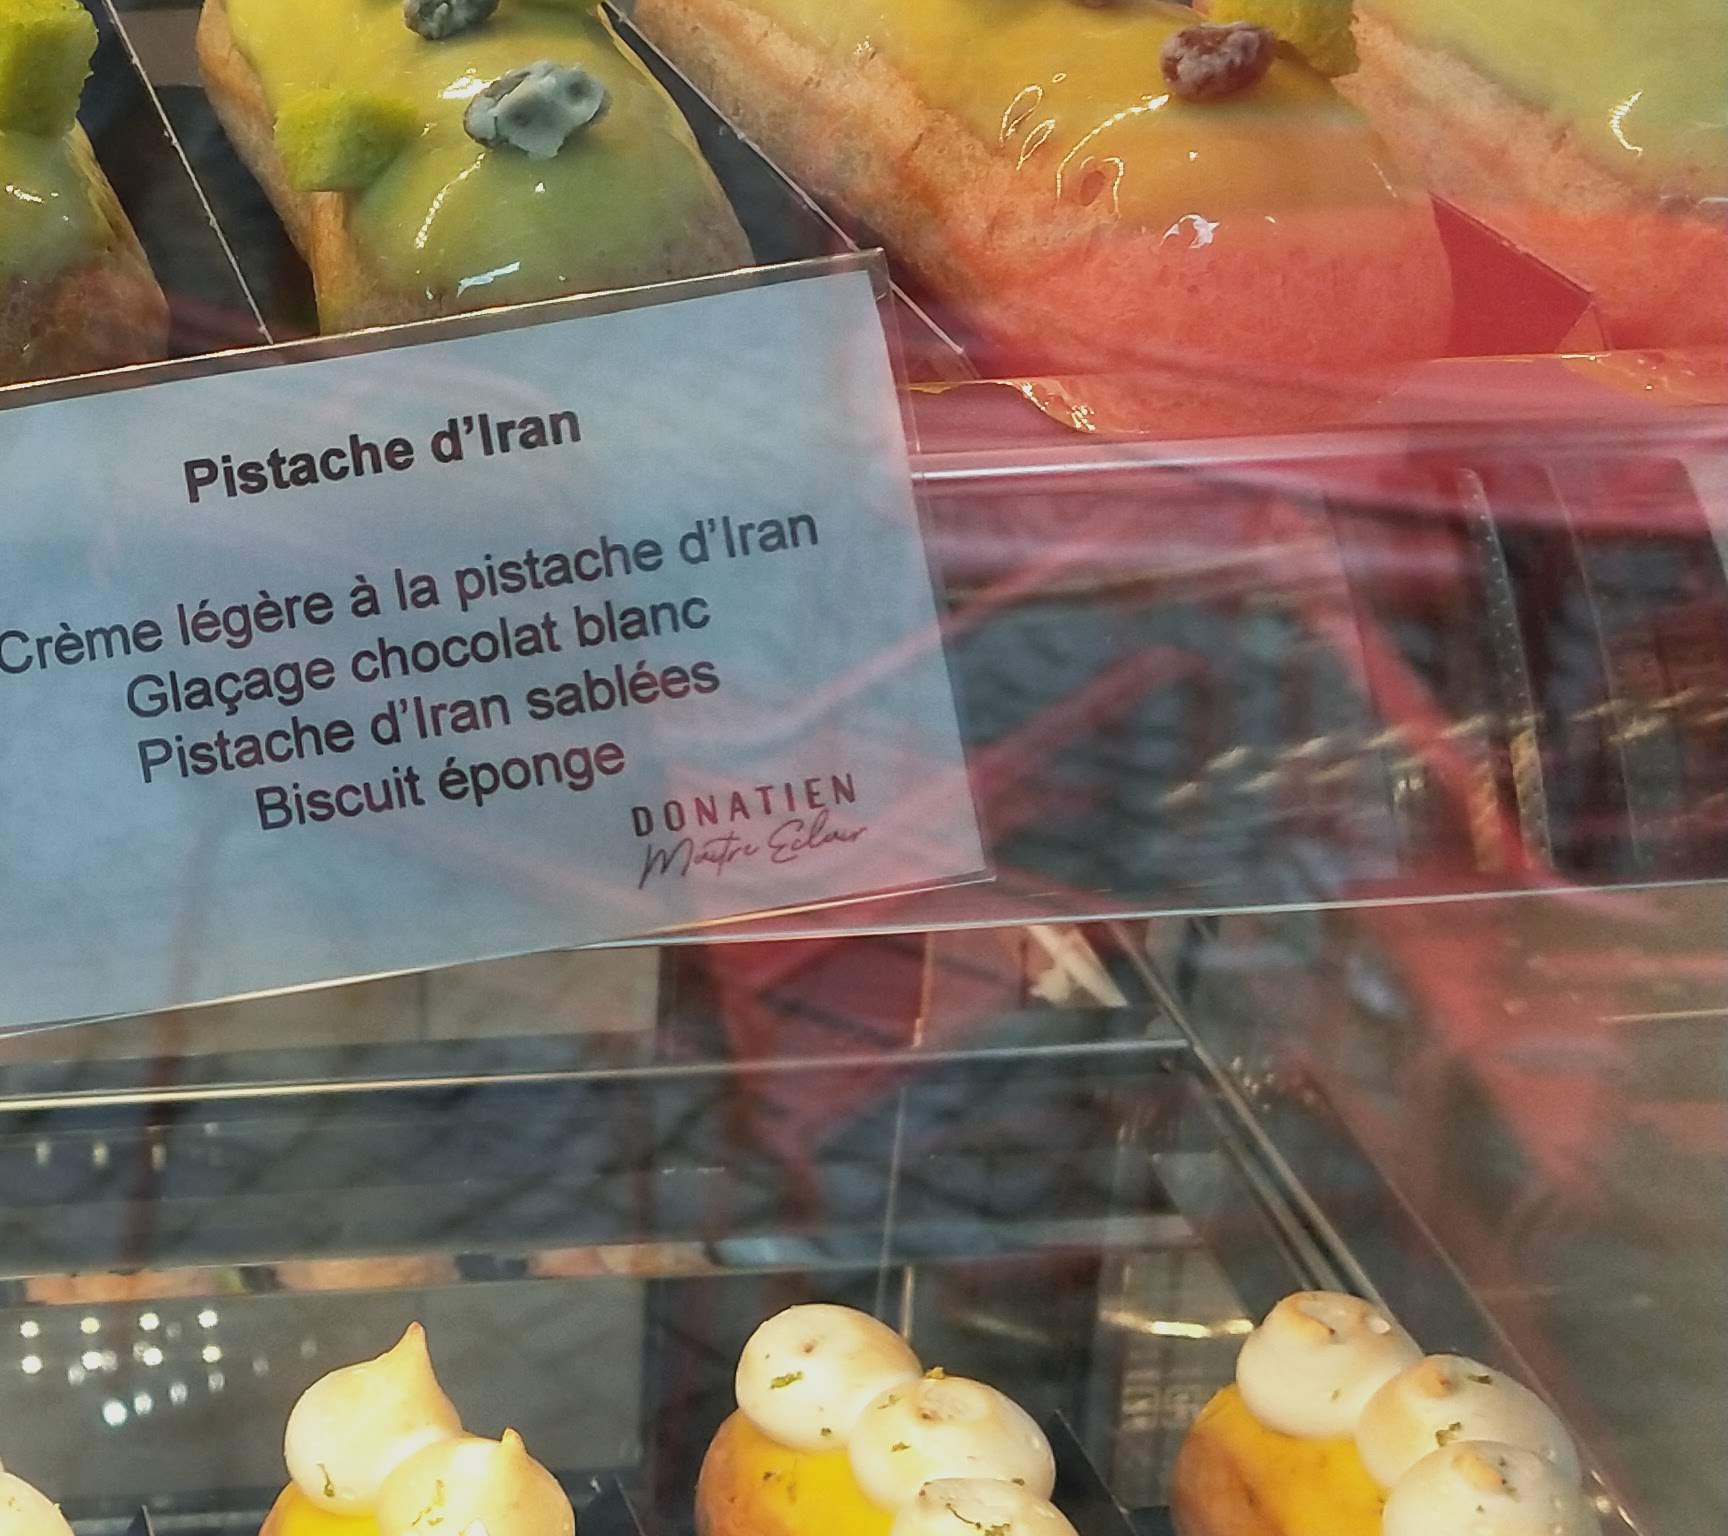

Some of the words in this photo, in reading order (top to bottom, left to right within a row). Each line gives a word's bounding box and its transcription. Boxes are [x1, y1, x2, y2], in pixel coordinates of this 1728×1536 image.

[183, 433, 415, 503] Pistache
[178, 591, 335, 649] légère
[349, 575, 379, 617] à
[394, 568, 440, 610] la
[455, 536, 664, 601] pistache
[125, 654, 336, 716] Glaçage
[350, 616, 560, 683] chocolat
[574, 595, 712, 649] blanc
[138, 716, 355, 785] Pistache
[526, 659, 721, 725] sablées
[256, 768, 425, 830] Biscuit
[438, 742, 625, 806] éponge
[631, 772, 856, 836] DONATIEN
